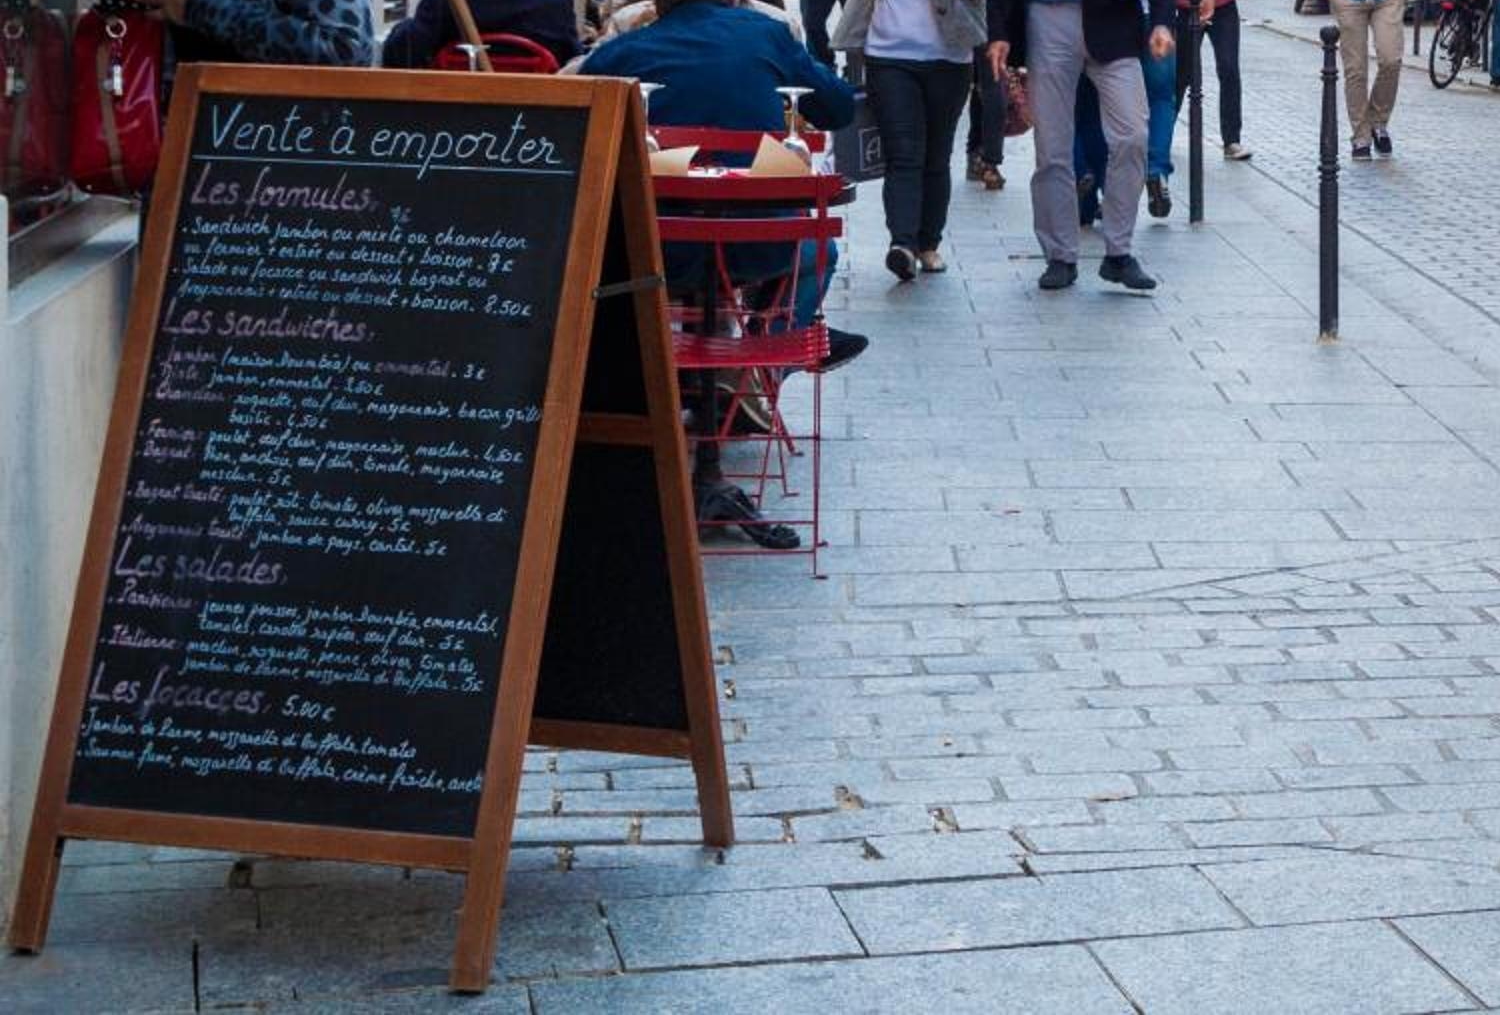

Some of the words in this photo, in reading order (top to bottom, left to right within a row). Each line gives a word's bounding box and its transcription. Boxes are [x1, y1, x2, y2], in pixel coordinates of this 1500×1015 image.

[212, 102, 316, 152] Vente
[330, 108, 356, 155] à
[370, 112, 562, 181] emporter
[191, 161, 239, 205] Les
[326, 248, 347, 261] ou
[331, 226, 353, 241] ou
[408, 233, 429, 244] ou
[231, 265, 249, 275] ou
[308, 269, 327, 281] ou
[467, 278, 487, 288] ou
[162, 296, 213, 334] Les
[115, 535, 166, 578] Les
[88, 660, 141, 706] Les
